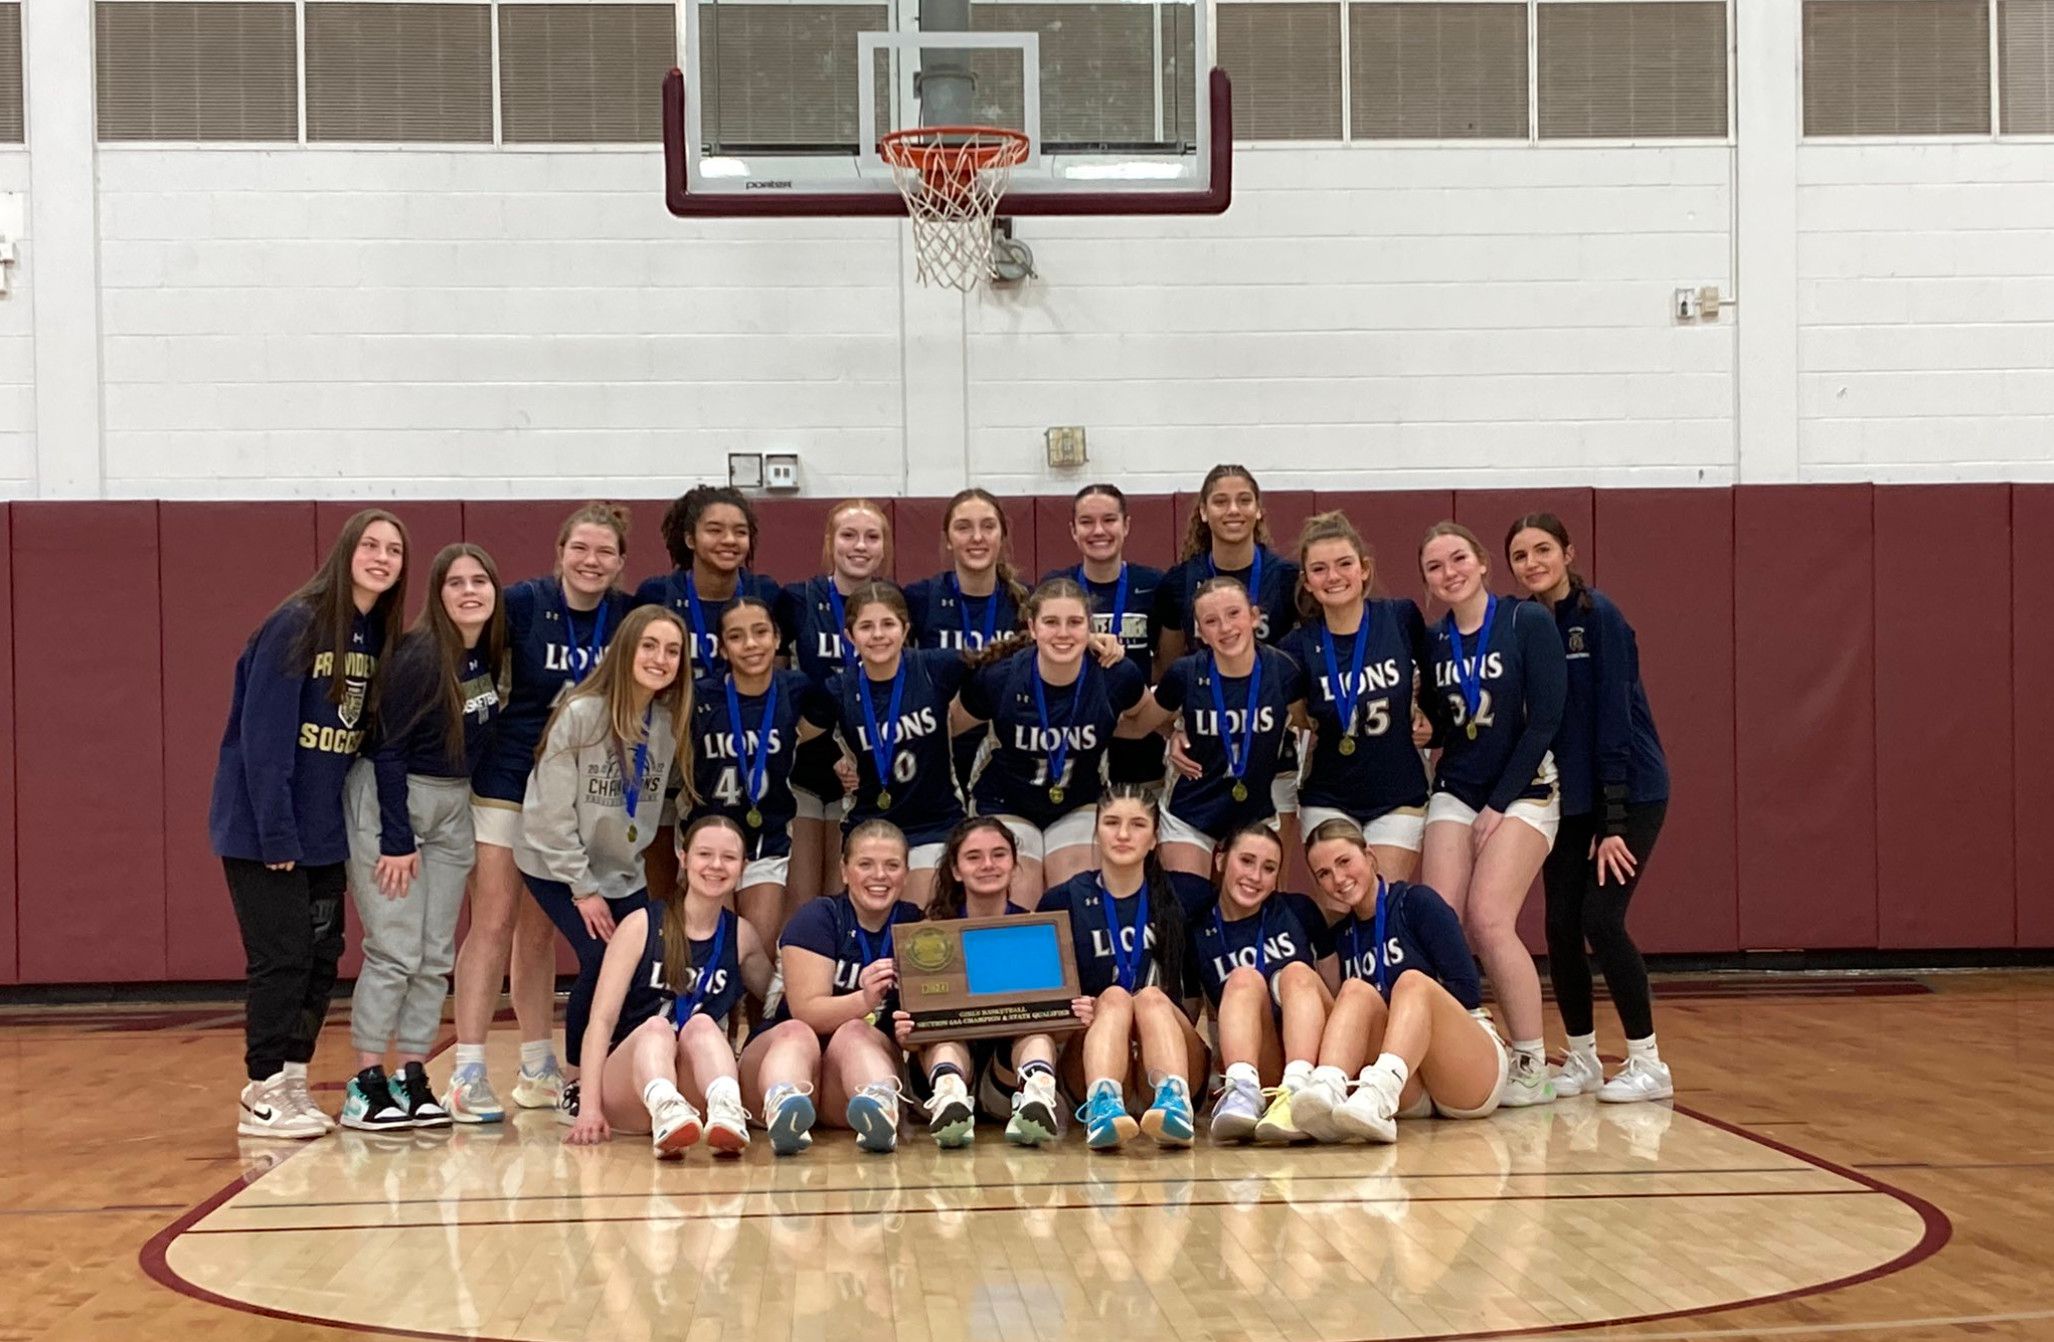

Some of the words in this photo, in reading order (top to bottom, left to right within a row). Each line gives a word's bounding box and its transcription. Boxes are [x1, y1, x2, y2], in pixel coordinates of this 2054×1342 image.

[298, 722, 366, 755] SOCC
[1014, 723, 1097, 751] LIONS
[1089, 922, 1158, 958] LON
[1212, 931, 1297, 983] LIONS
